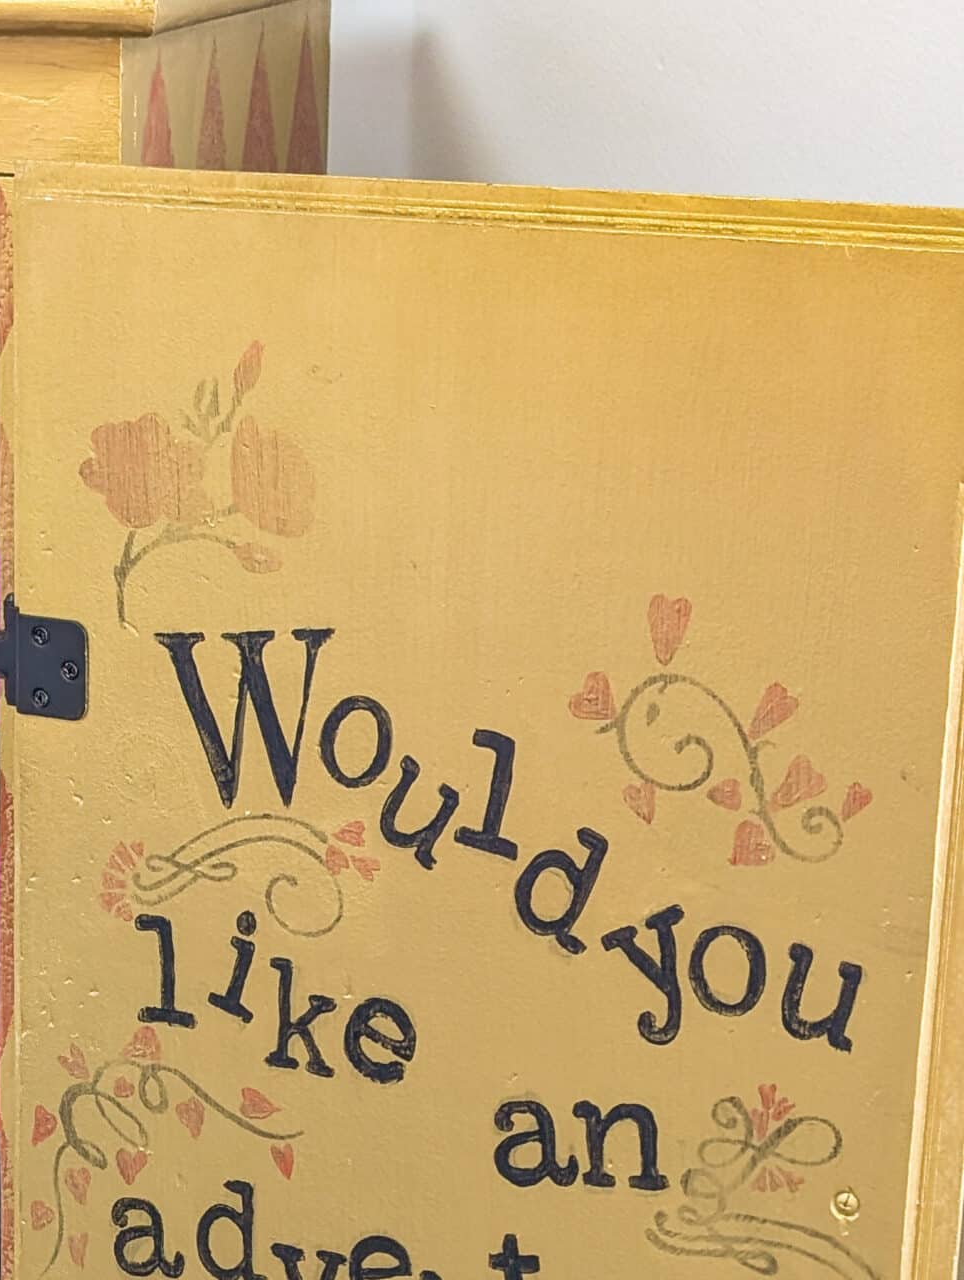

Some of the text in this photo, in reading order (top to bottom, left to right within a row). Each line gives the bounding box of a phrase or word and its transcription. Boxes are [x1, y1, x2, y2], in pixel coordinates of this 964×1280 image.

[154, 627, 863, 1054] Would you
[134, 910, 670, 1191] like an
